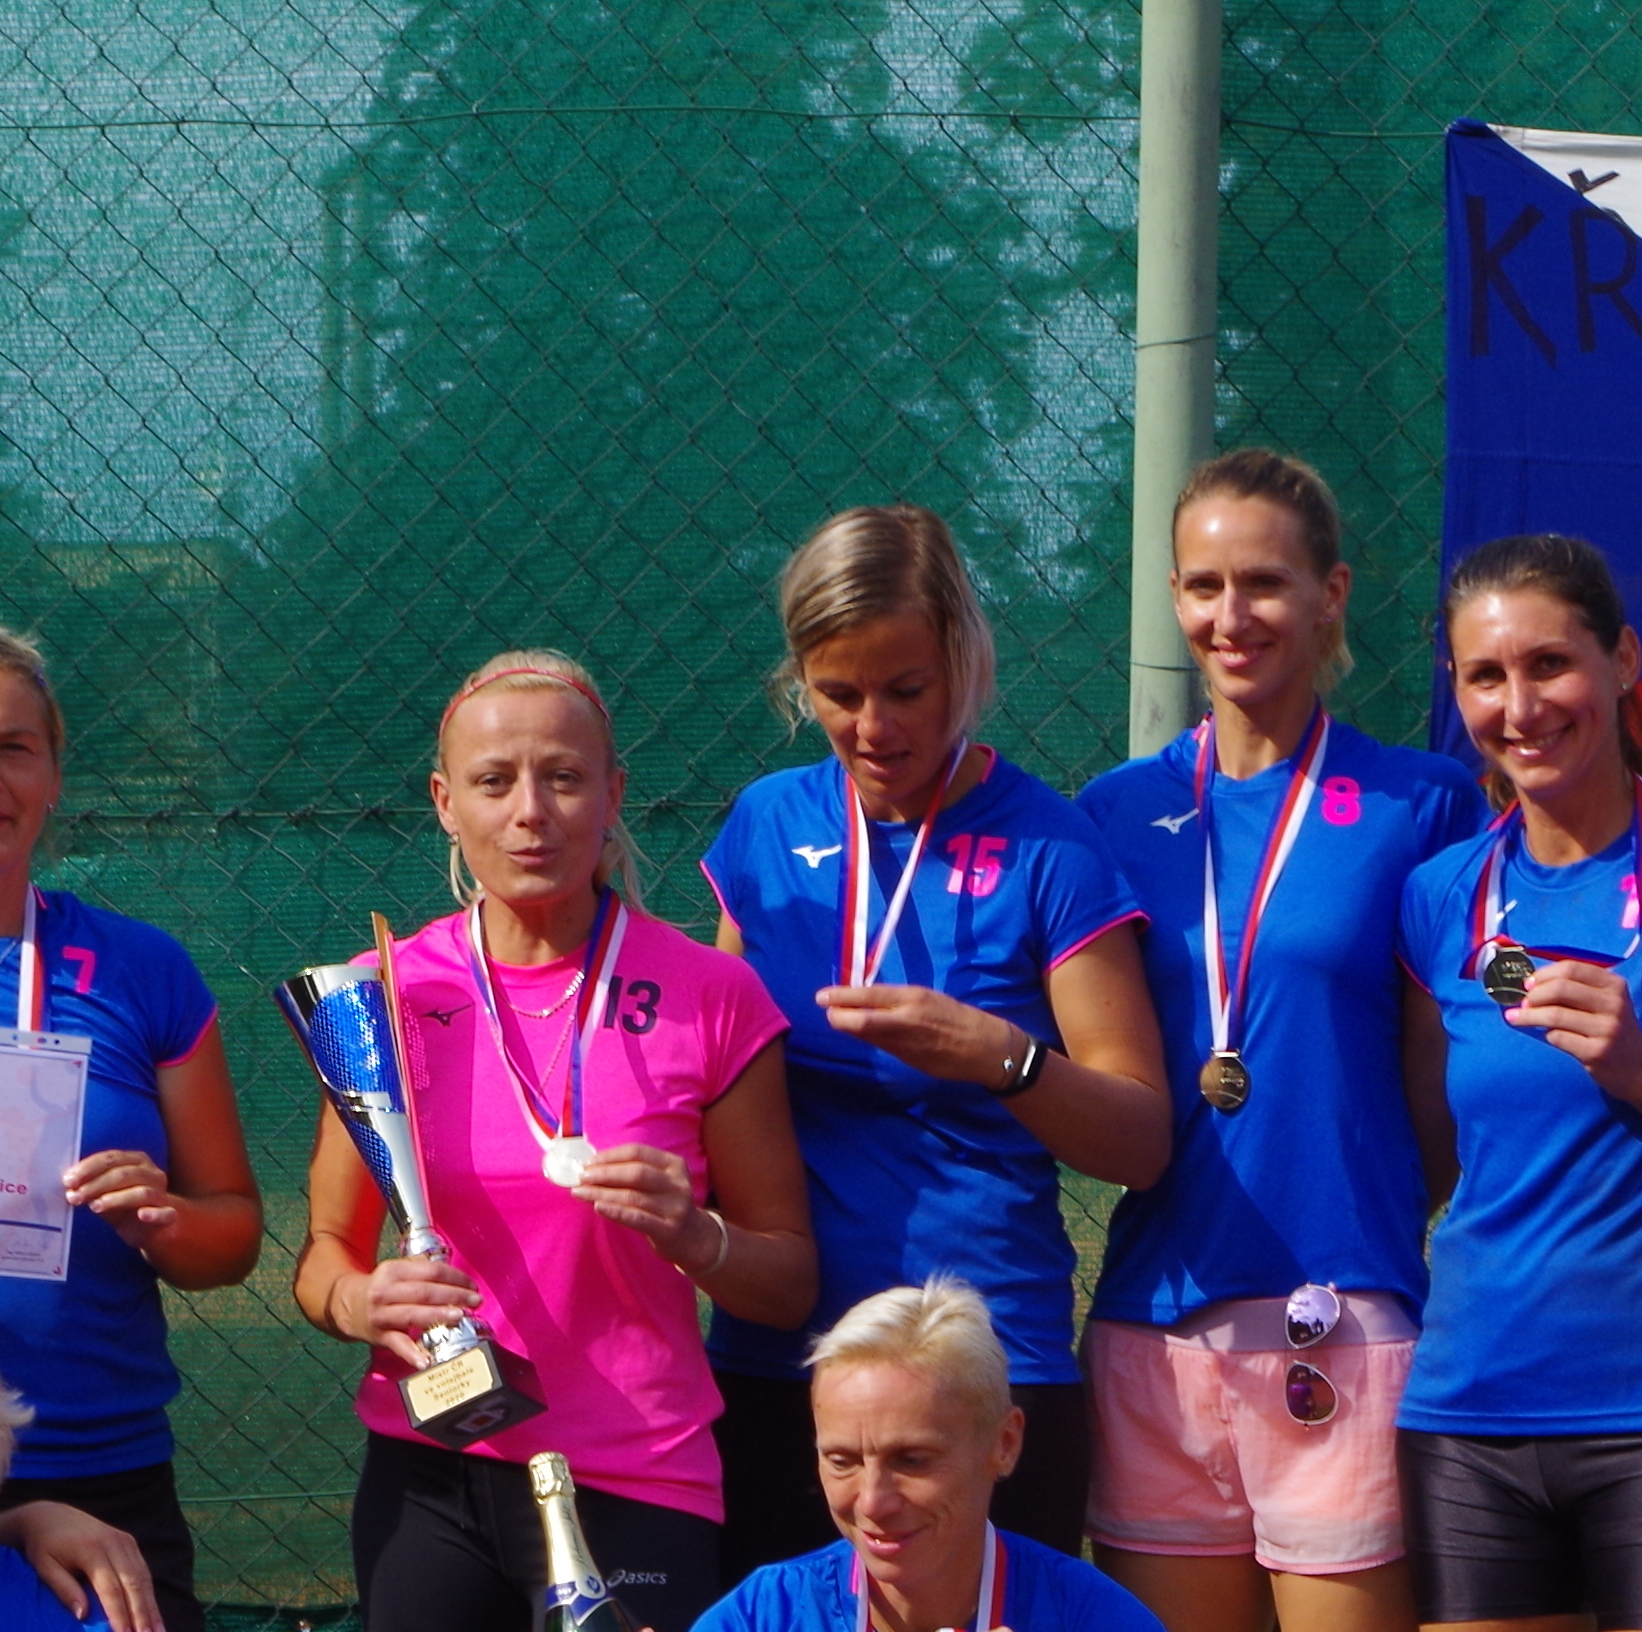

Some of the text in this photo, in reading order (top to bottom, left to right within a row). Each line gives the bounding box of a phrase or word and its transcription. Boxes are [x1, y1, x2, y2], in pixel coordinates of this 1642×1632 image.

[1321, 776, 1362, 826] 8
[947, 833, 1008, 897] 15
[62, 945, 96, 994] 7
[604, 975, 661, 1034] 13
